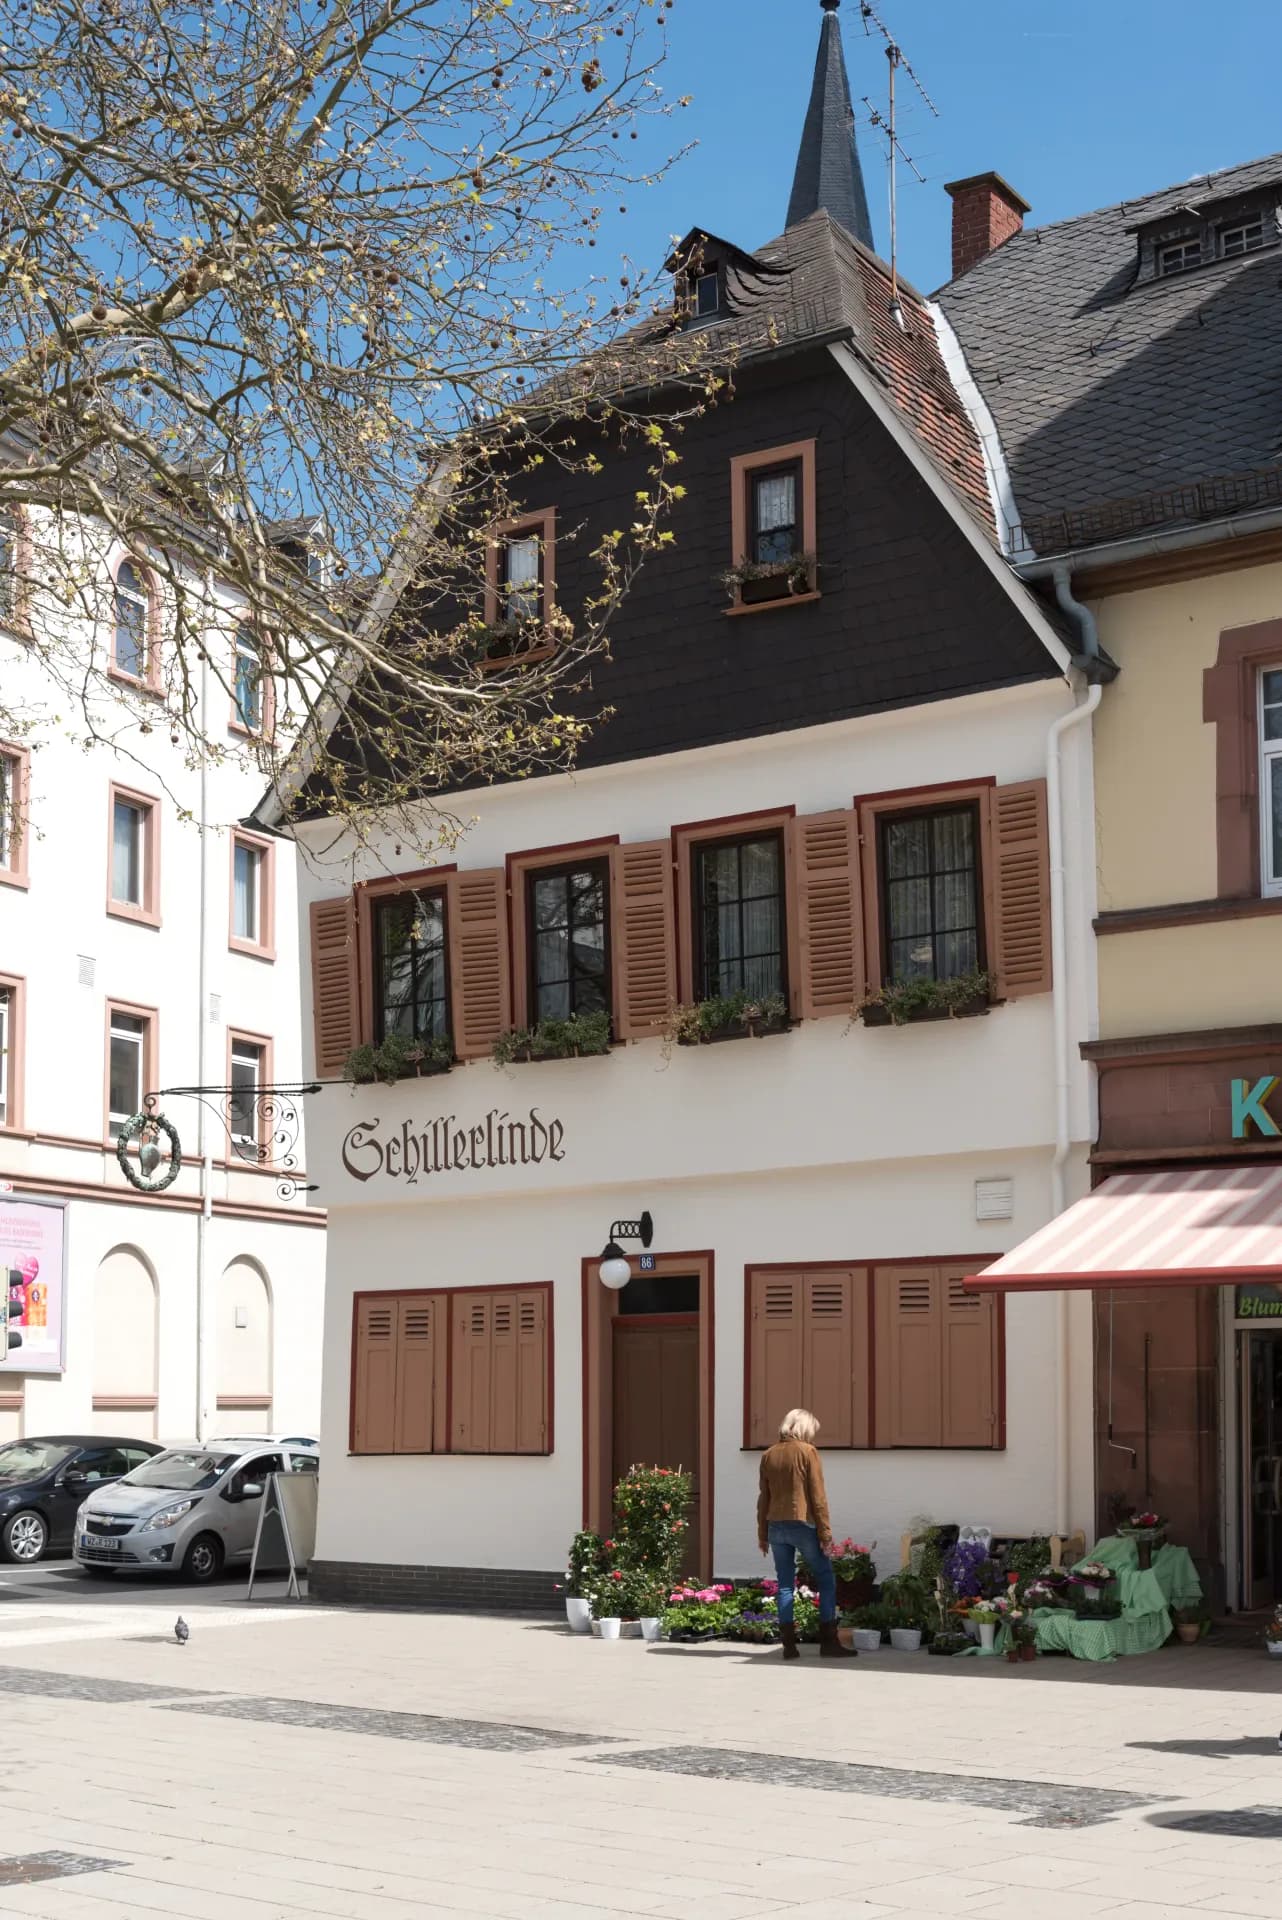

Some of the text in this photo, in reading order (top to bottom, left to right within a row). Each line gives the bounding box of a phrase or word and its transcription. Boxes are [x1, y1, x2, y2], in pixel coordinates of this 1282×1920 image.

[1231, 1075, 1282, 1138] K
[341, 1107, 566, 1184] Schillerlinde
[641, 1256, 652, 1269] 86
